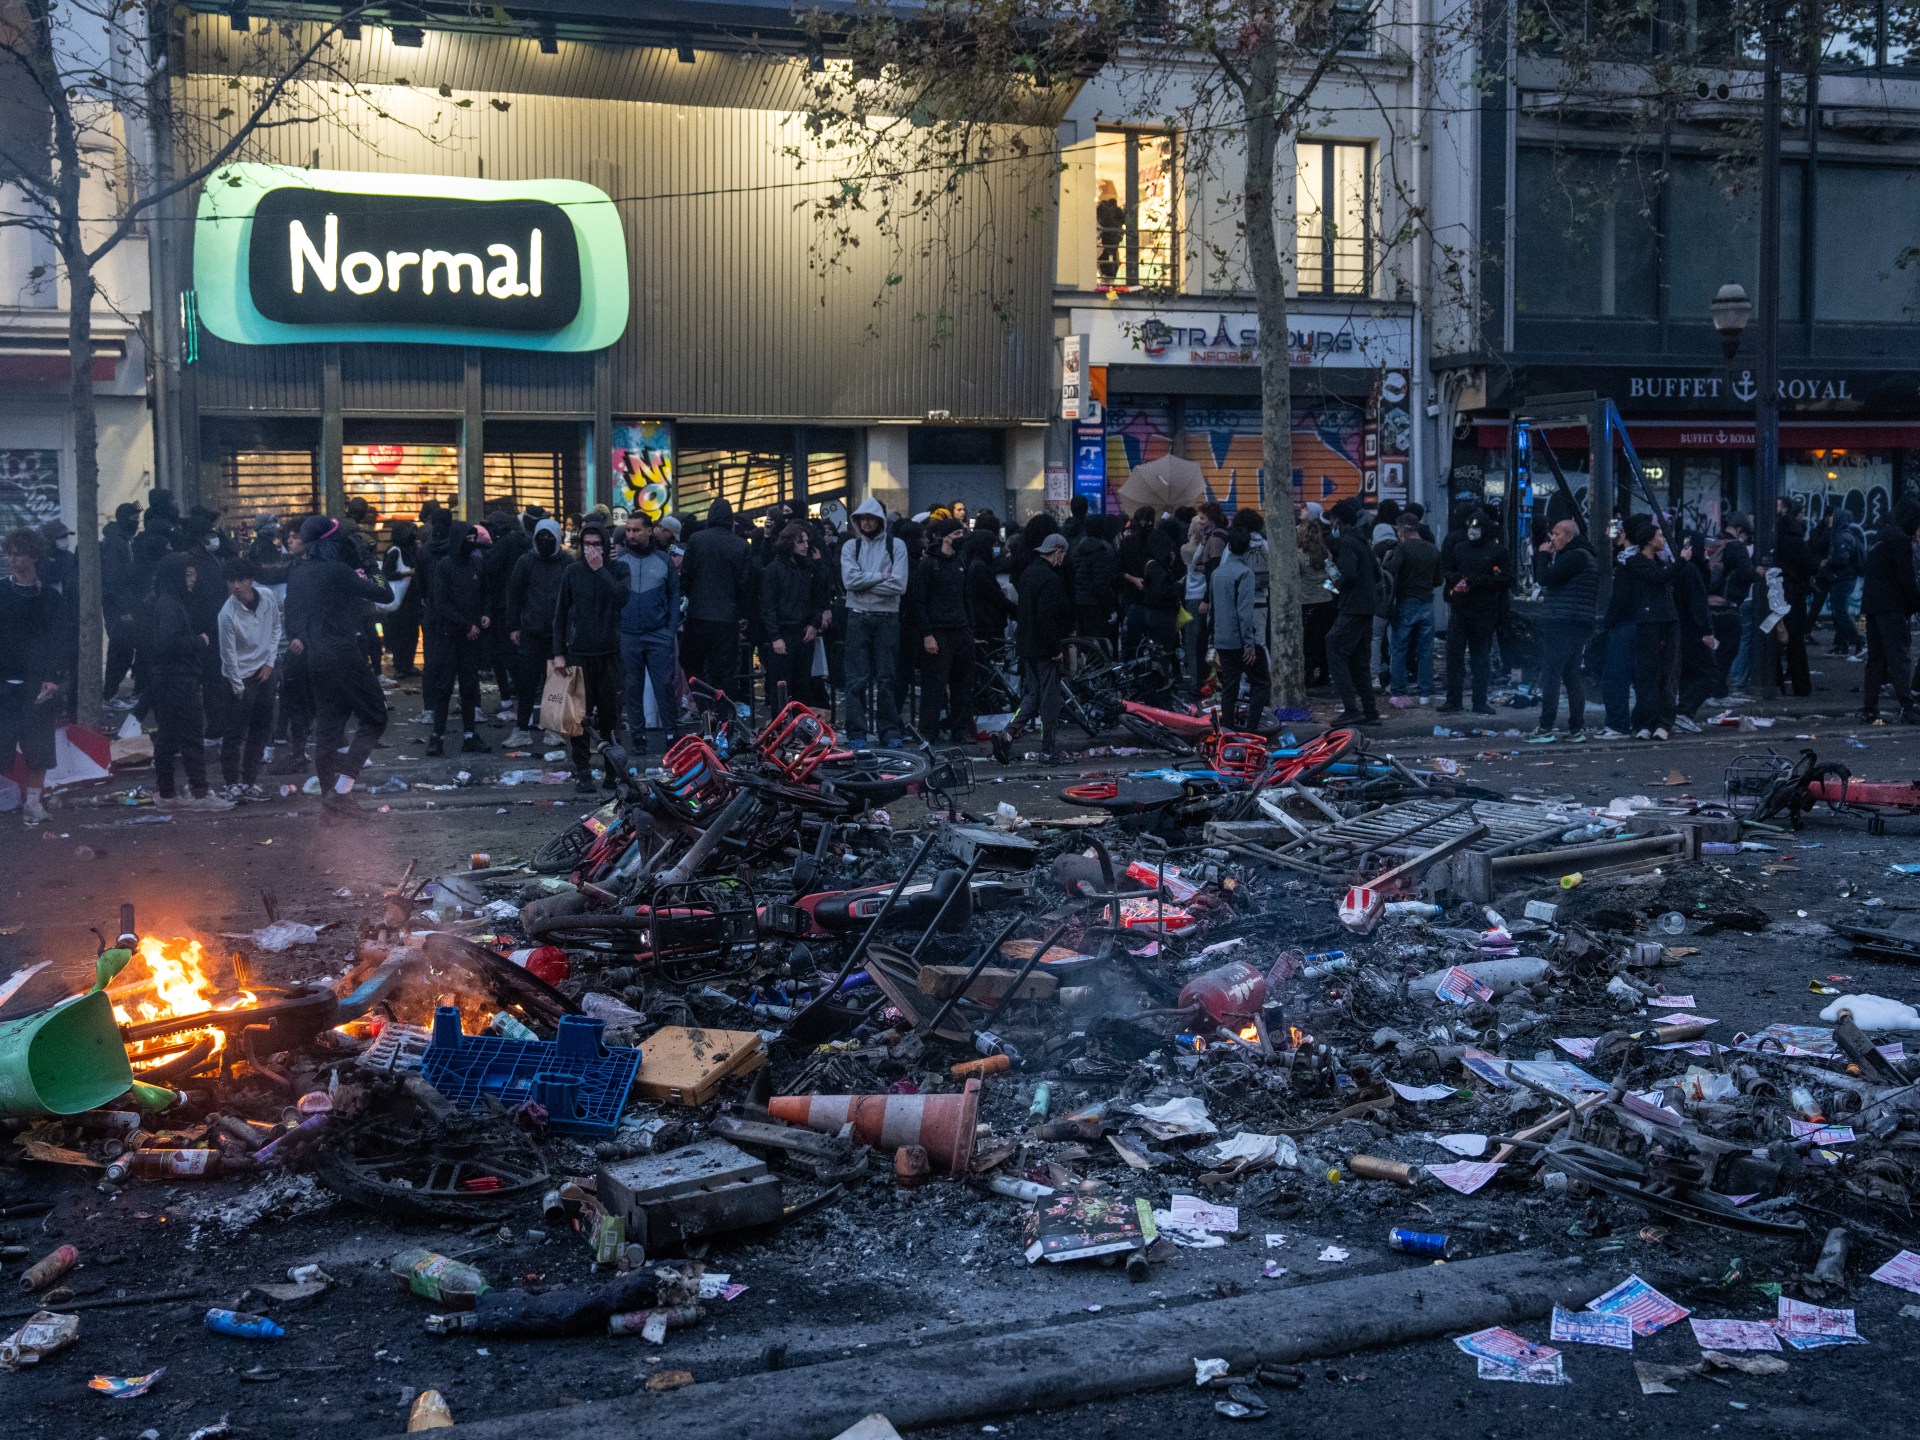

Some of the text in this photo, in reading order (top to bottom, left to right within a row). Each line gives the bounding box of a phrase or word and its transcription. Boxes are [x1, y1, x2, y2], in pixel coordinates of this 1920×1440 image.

[289, 213, 542, 299] Normal
[1630, 377, 1852, 399] BUFFET ROYAL
[1680, 433, 1714, 443] BUFFET
